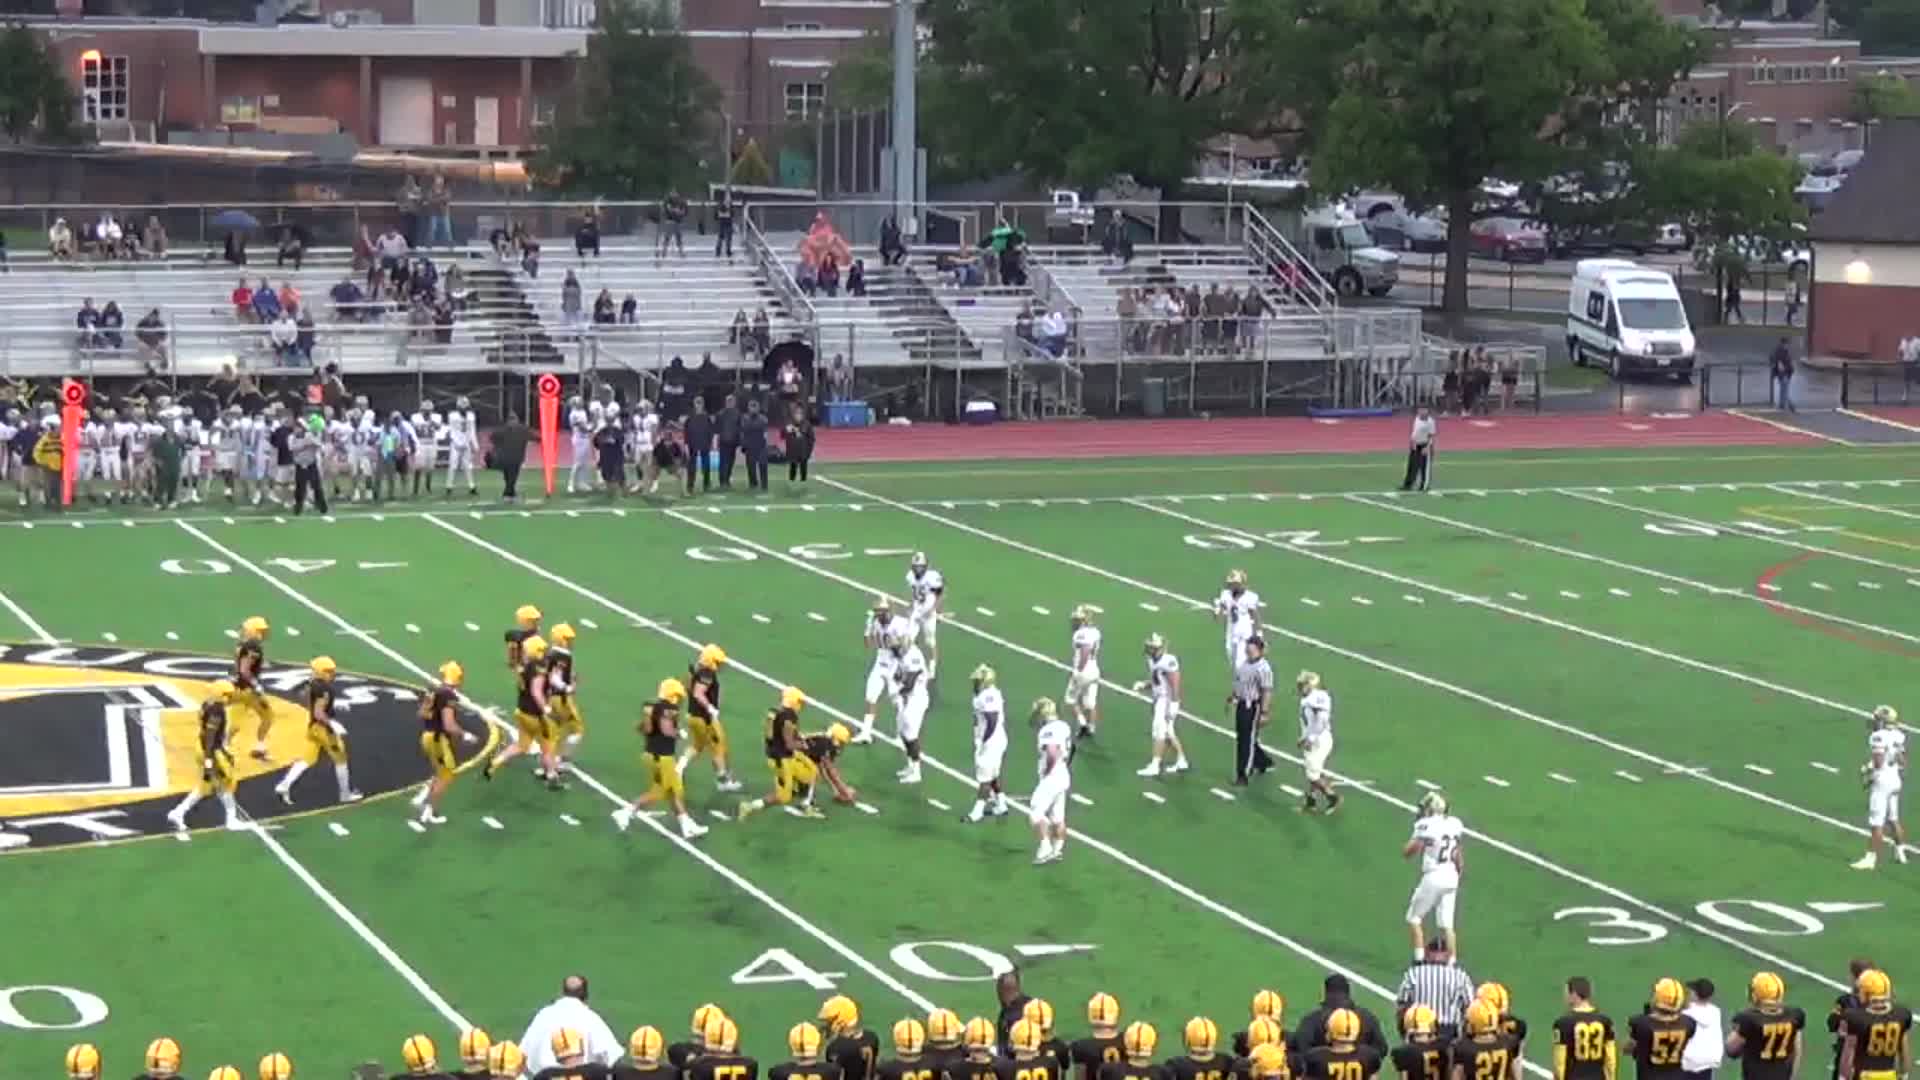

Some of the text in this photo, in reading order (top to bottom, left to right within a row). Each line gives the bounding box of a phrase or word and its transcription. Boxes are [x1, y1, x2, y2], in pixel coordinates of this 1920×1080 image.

[1552, 899, 1825, 946] 30
[731, 940, 1014, 991] 40
[1573, 1021, 1605, 1061] 83
[1650, 1029, 1688, 1065] 57
[1760, 1022, 1793, 1060] 77
